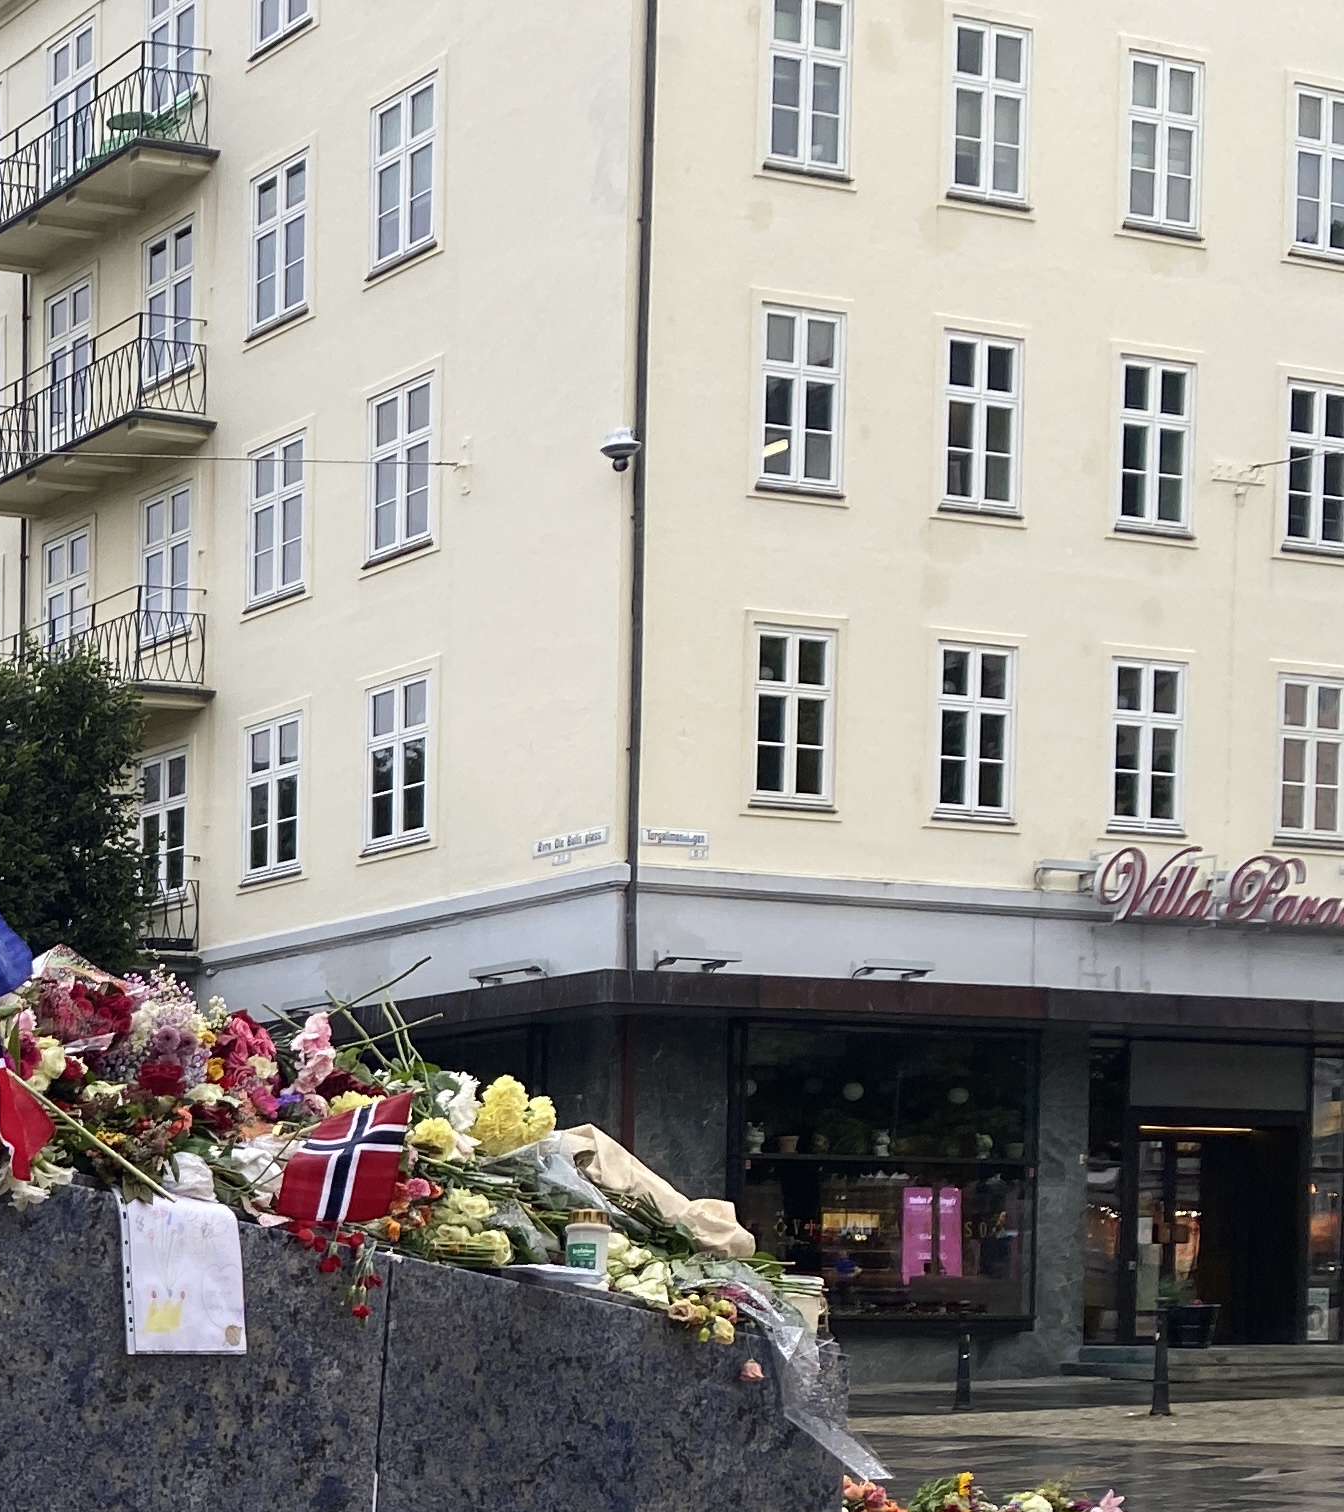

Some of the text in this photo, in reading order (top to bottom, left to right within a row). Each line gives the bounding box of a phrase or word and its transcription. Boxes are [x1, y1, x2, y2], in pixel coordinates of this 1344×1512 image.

[585, 830, 602, 844] plass
[1099, 845, 1344, 924] Villa Para
